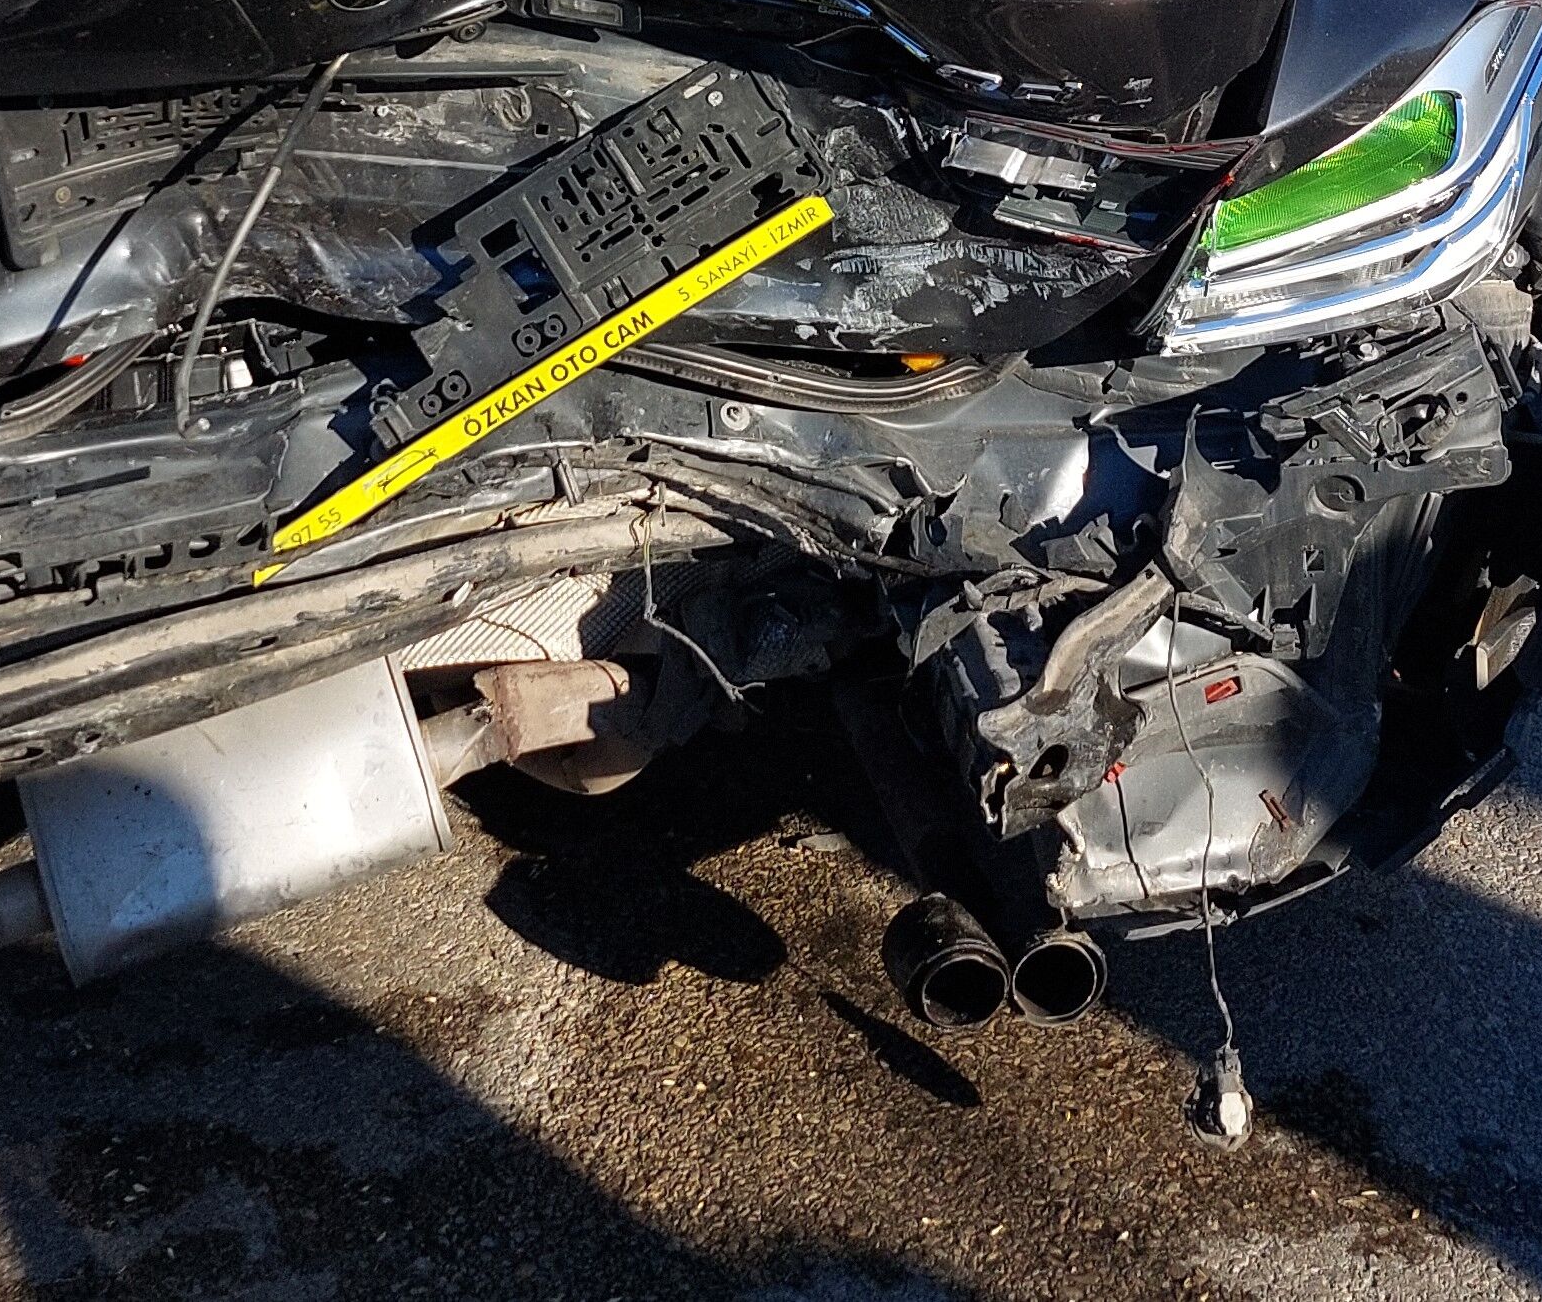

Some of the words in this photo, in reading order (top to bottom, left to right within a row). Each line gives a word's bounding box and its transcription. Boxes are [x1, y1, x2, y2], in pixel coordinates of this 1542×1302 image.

[696, 239, 758, 291] SANAYİ
[766, 205, 820, 245] İZMİR
[462, 376, 547, 437] ÖZKAN
[550, 344, 598, 382] OTO
[602, 310, 655, 349] CAM
[317, 506, 342, 532] 55
